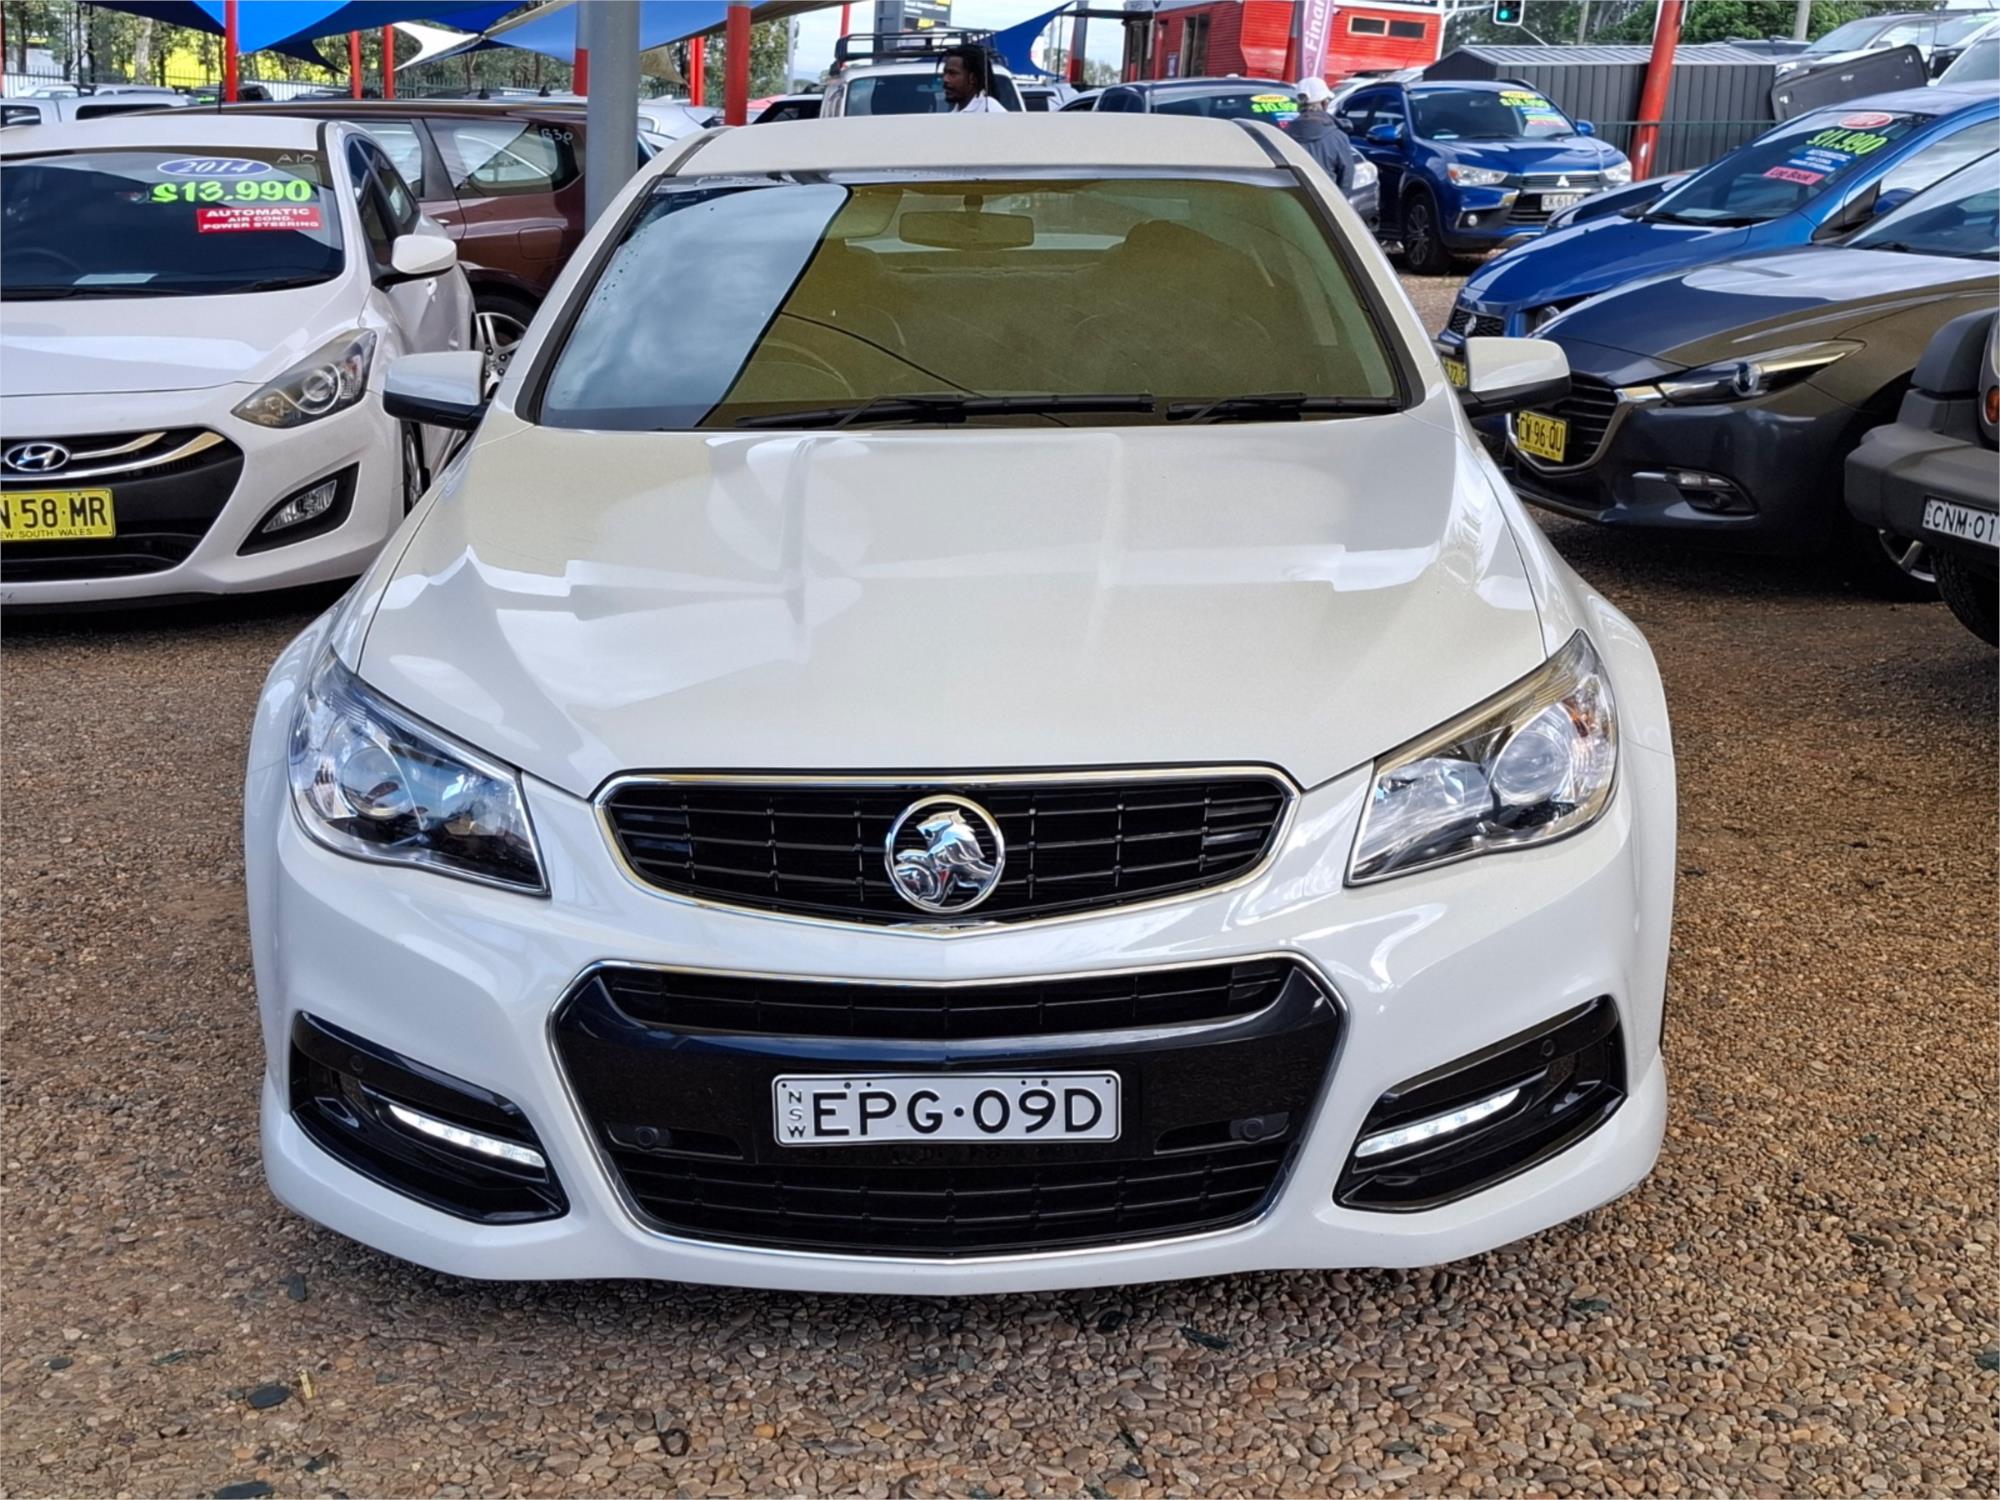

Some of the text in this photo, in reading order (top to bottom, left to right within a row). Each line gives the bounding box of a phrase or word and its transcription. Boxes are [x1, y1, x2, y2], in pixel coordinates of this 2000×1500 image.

[176, 160, 255, 173] 2014
[206, 207, 310, 218] AUTOMATIC
[202, 220, 320, 230] POWER STEERING
[19, 530, 54, 538] SOUTH
[58, 528, 93, 536] WALES
[787, 1091, 807, 1139] NSW
